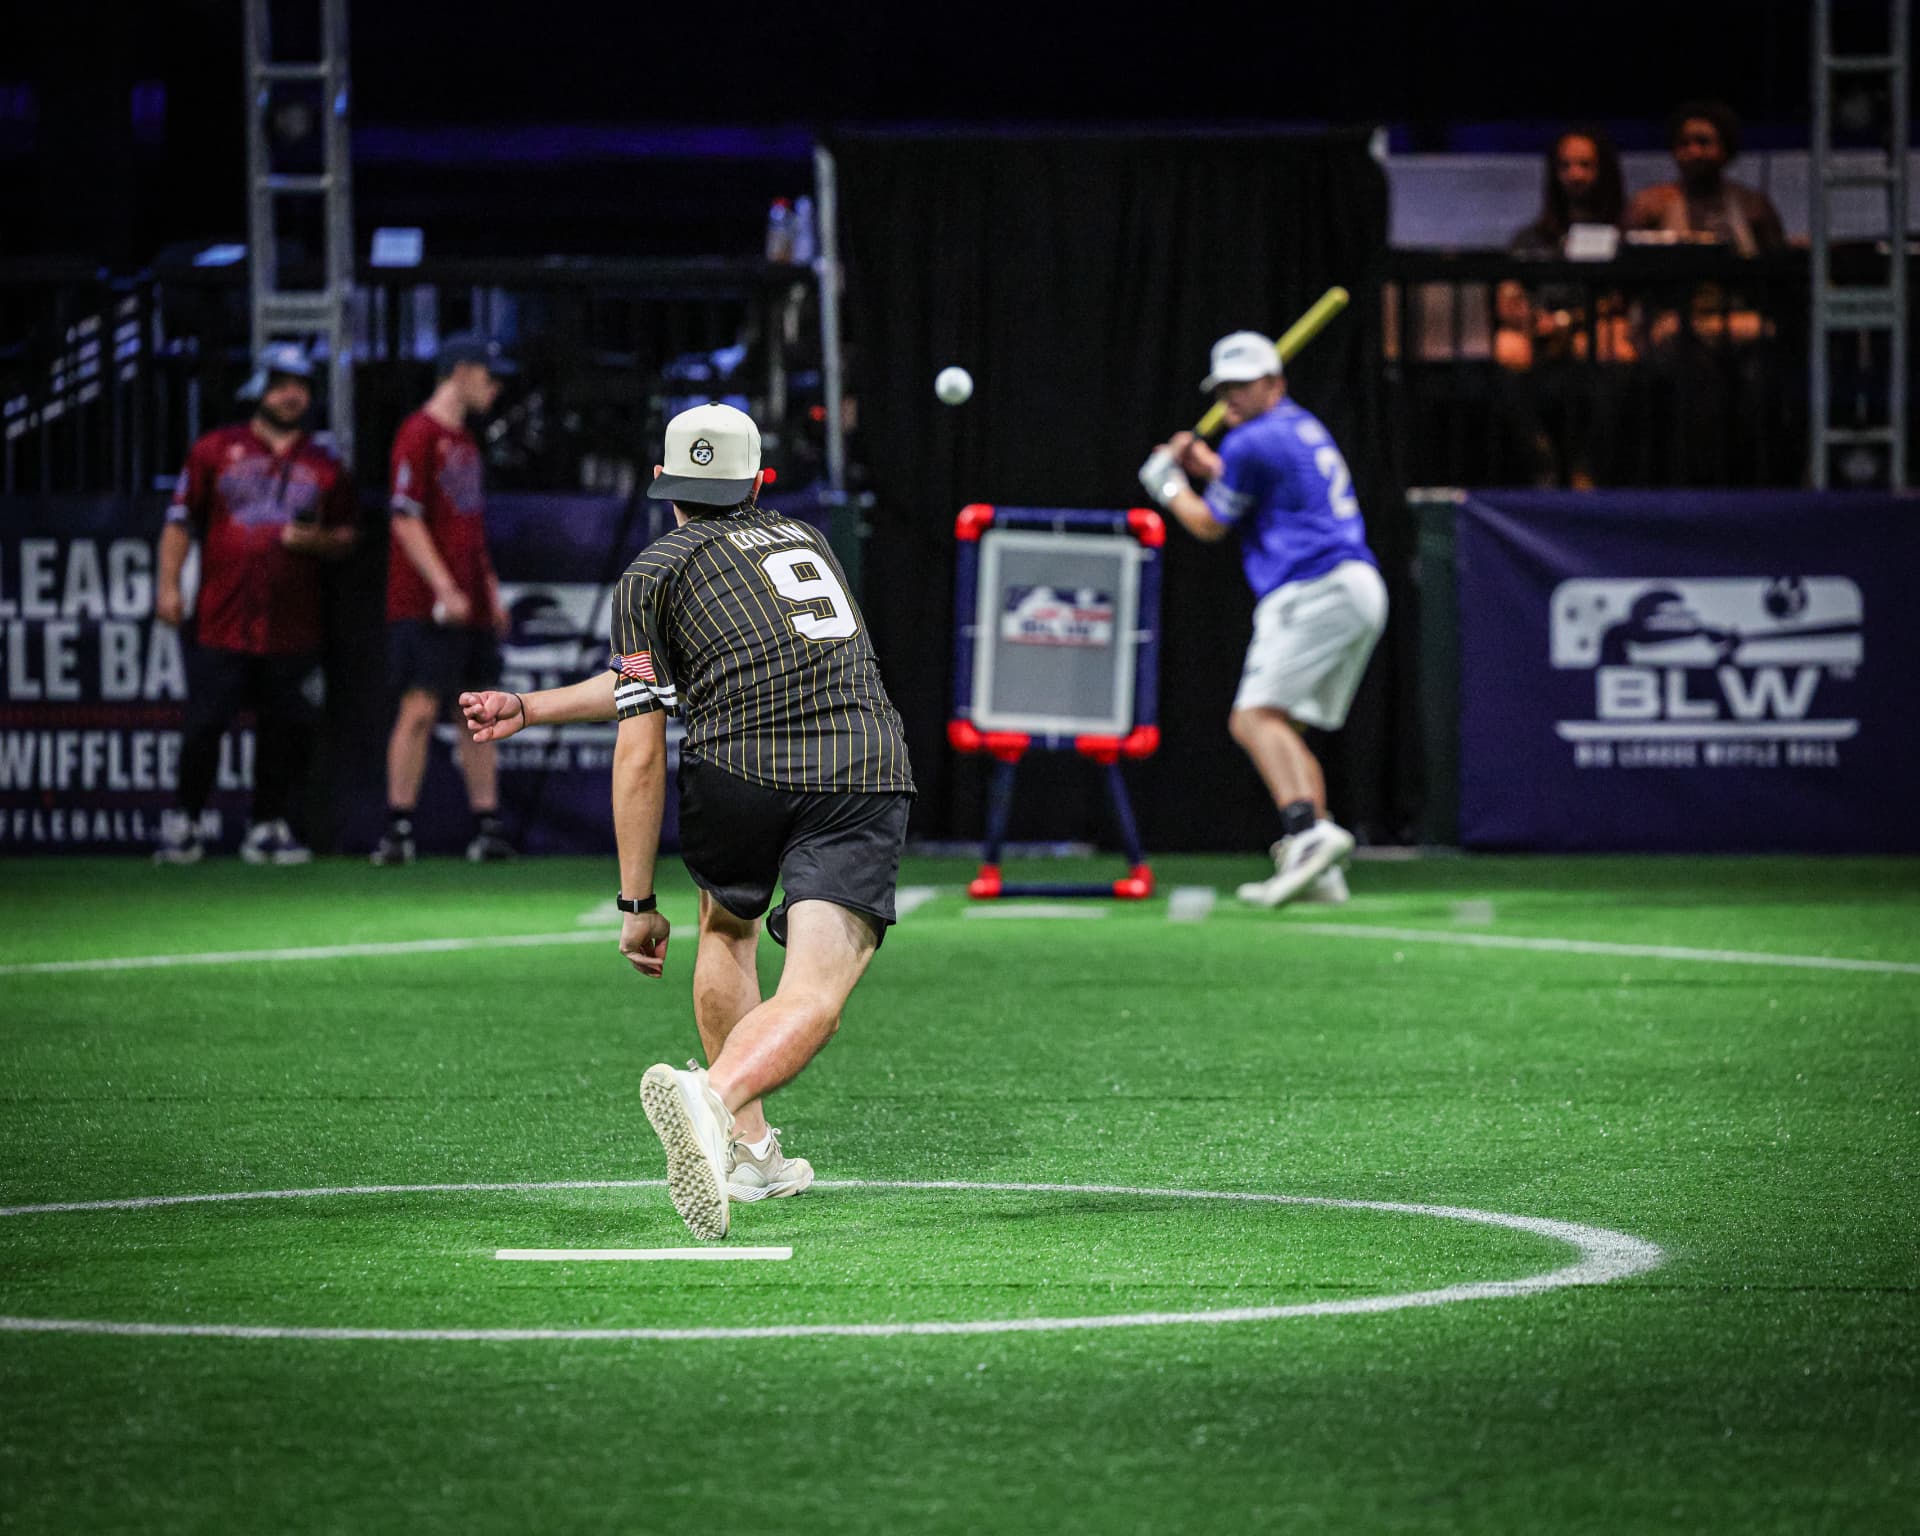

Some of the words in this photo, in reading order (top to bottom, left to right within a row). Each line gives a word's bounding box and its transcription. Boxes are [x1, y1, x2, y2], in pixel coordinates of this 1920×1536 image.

[1314, 446, 1361, 520] 2
[759, 547, 860, 641] 9
[100, 621, 189, 700] BA
[1596, 666, 1821, 720] BLW
